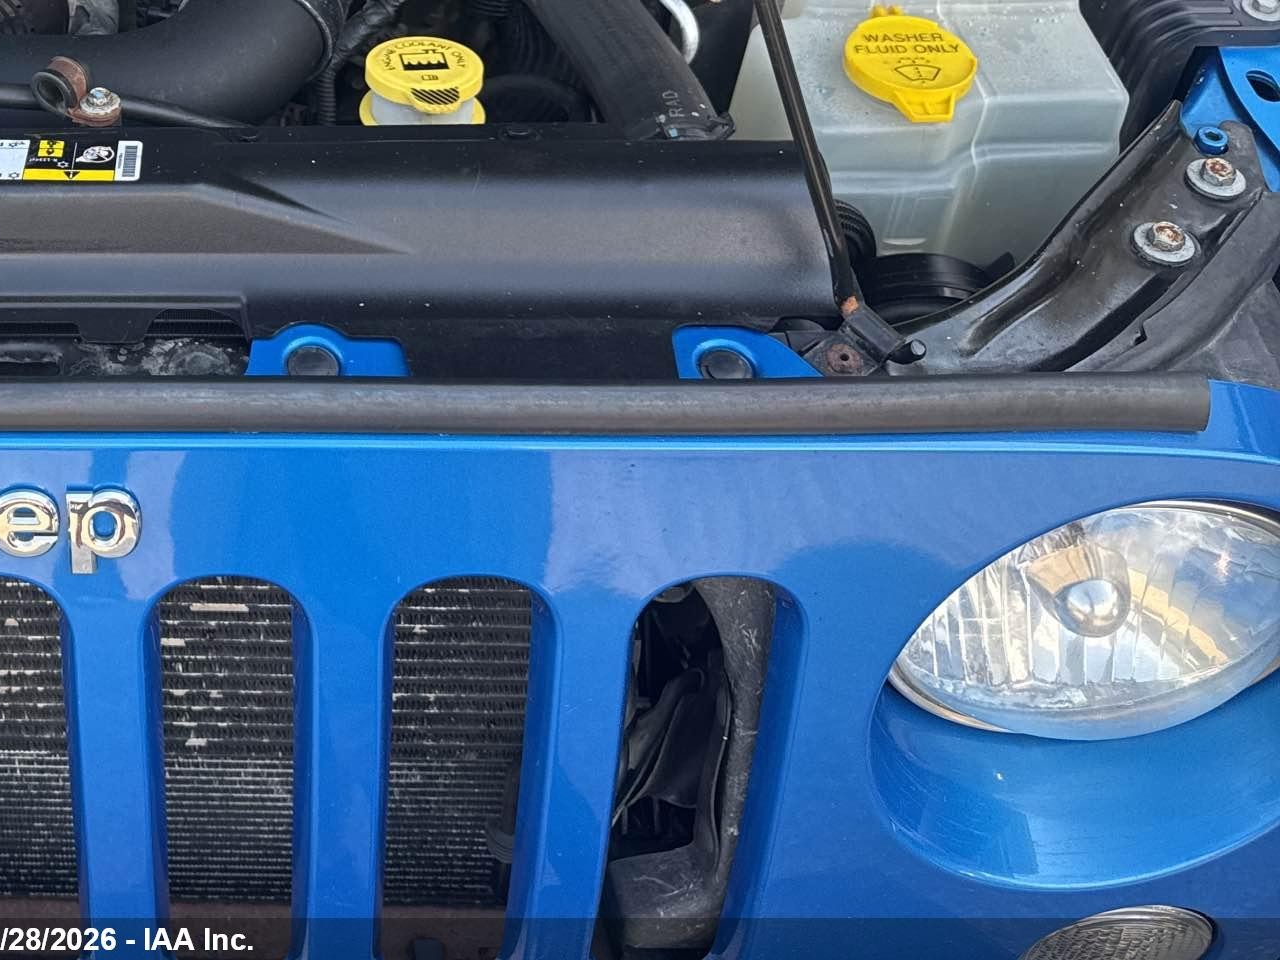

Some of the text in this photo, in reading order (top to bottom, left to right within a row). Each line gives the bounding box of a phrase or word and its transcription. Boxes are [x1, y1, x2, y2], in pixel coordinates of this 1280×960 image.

[864, 32, 943, 42] WASHER
[395, 41, 451, 51] COOLANT
[854, 43, 960, 54] FLUID ONLY
